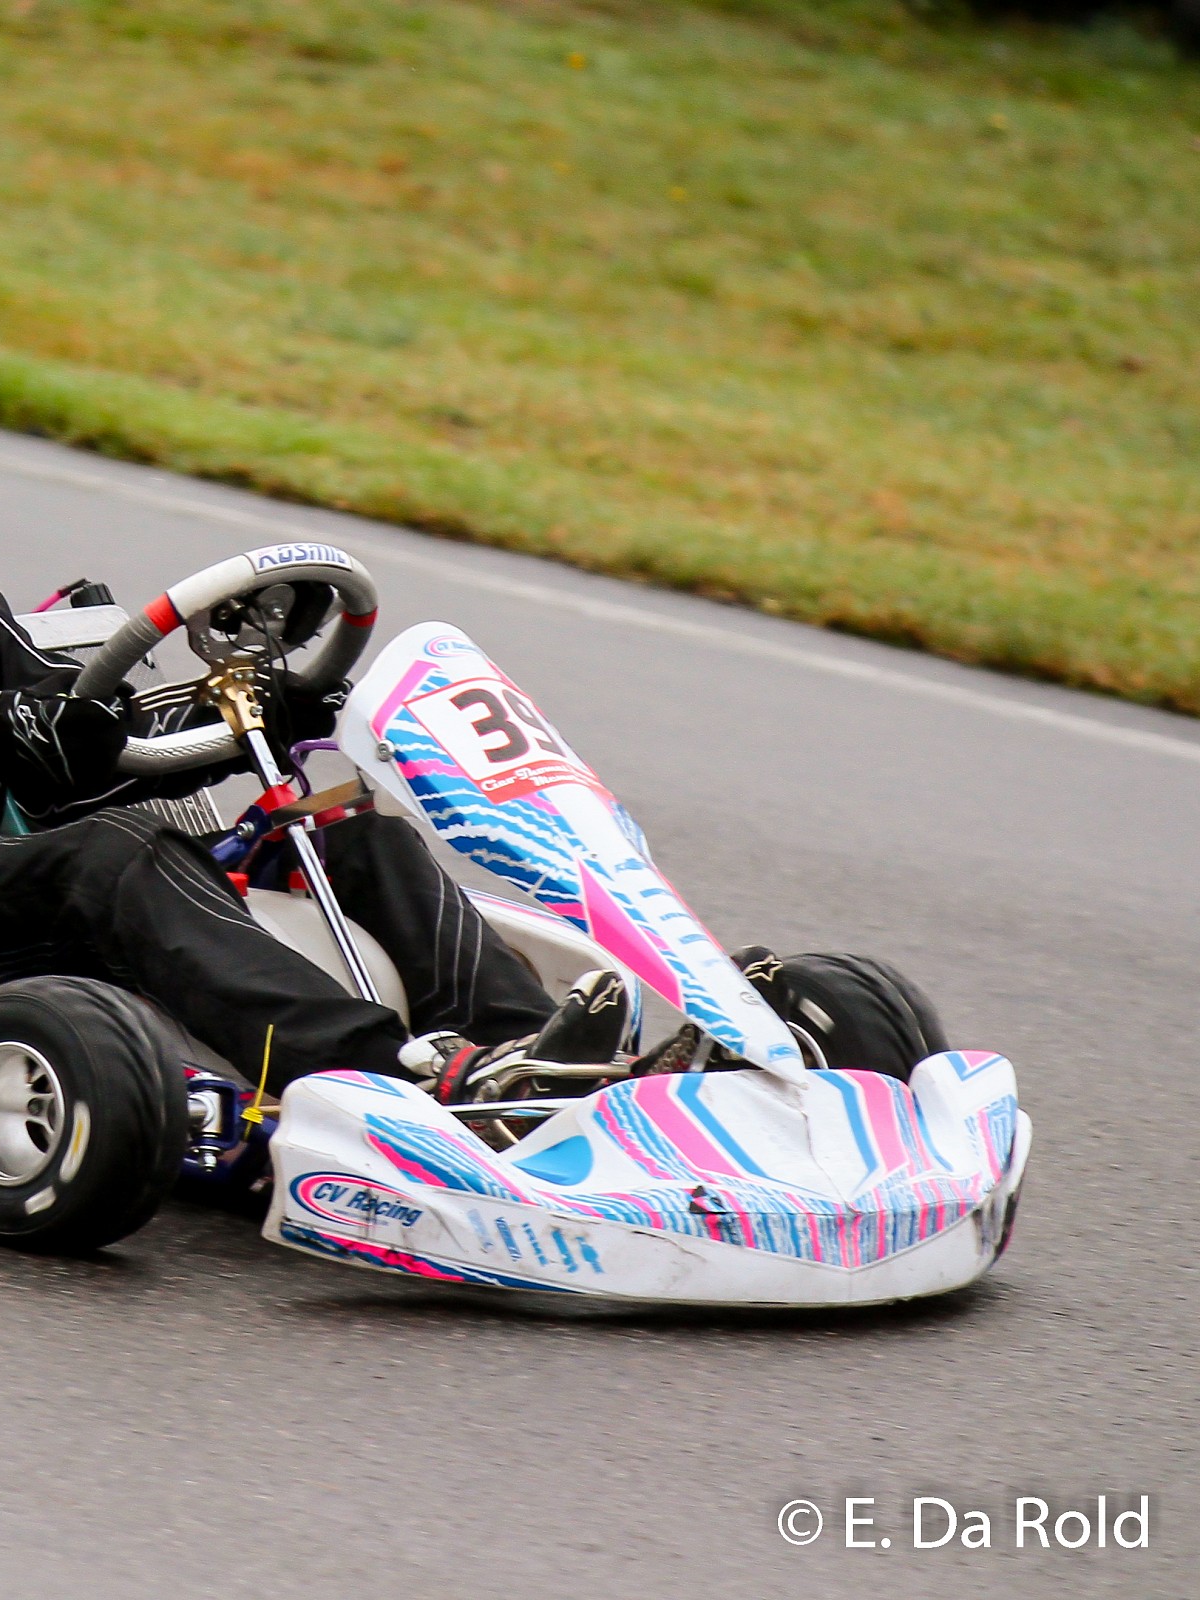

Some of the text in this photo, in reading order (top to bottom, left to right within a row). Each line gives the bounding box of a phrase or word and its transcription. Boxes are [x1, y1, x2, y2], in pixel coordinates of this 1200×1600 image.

[448, 687, 568, 764] 39
[313, 1182, 350, 1203] CV
[346, 1191, 424, 1227] Racing
